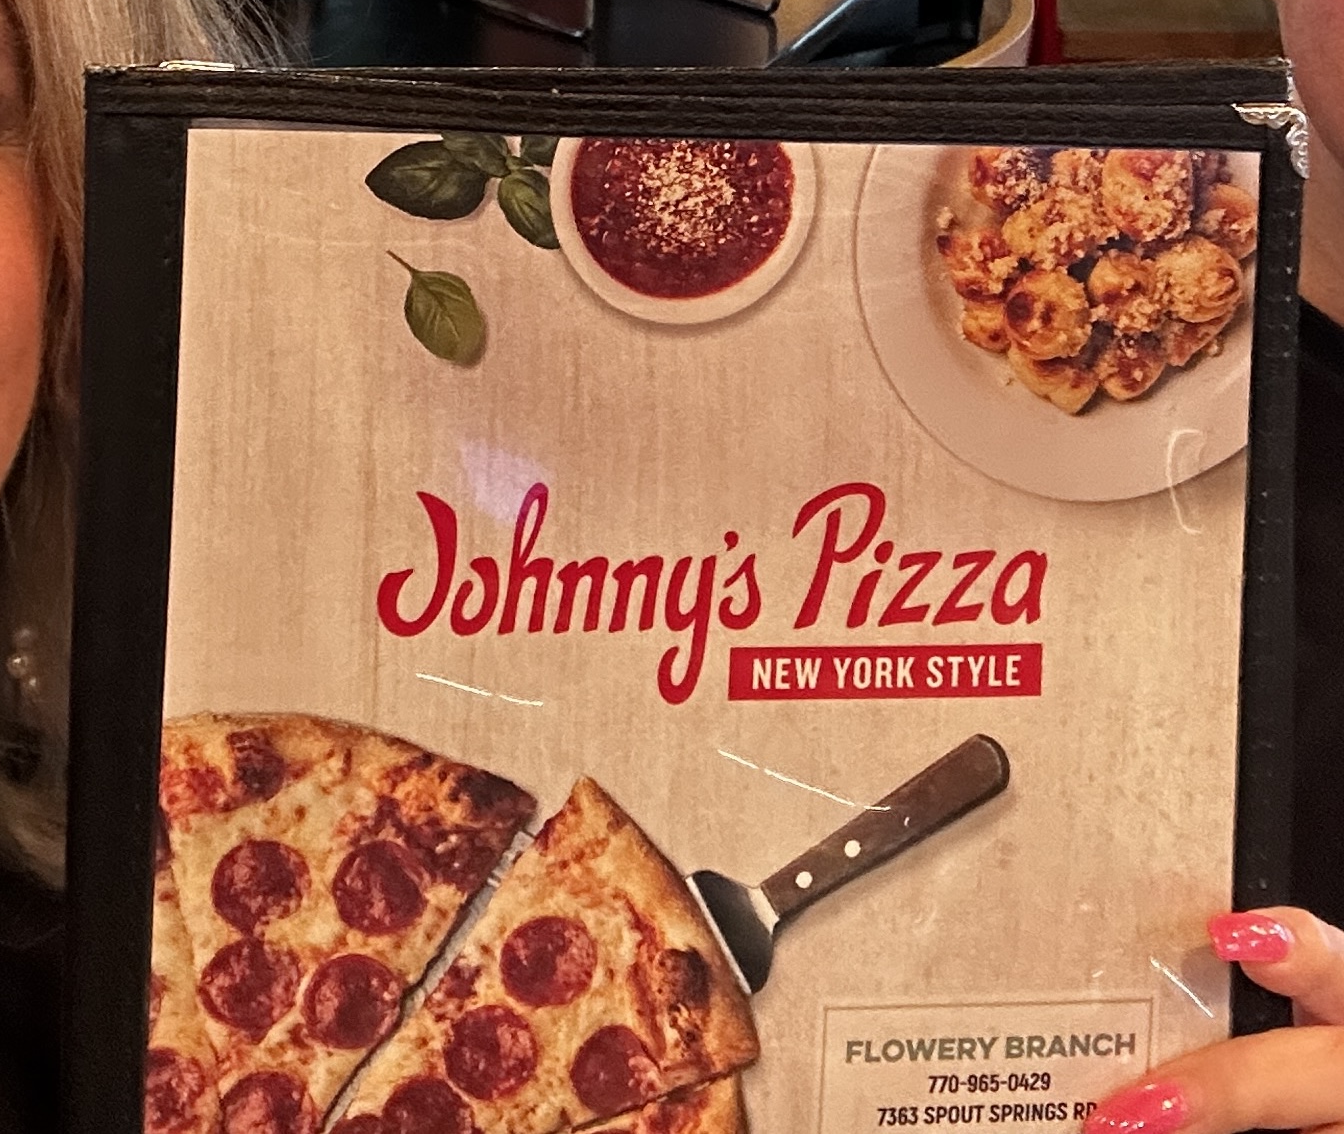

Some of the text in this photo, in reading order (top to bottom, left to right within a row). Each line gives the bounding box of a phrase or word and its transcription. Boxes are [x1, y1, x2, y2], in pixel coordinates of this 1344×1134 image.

[376, 482, 1048, 705] Johnny's Pizza
[752, 654, 1022, 690] NEW YORK STYLE
[845, 1033, 1137, 1064] FLOWERY BRANCH
[927, 1073, 1051, 1094] 770-965-0429
[877, 1107, 919, 1127] 7363
[924, 1105, 983, 1125] SPOUT
[988, 1102, 1068, 1123] SPRINGS
